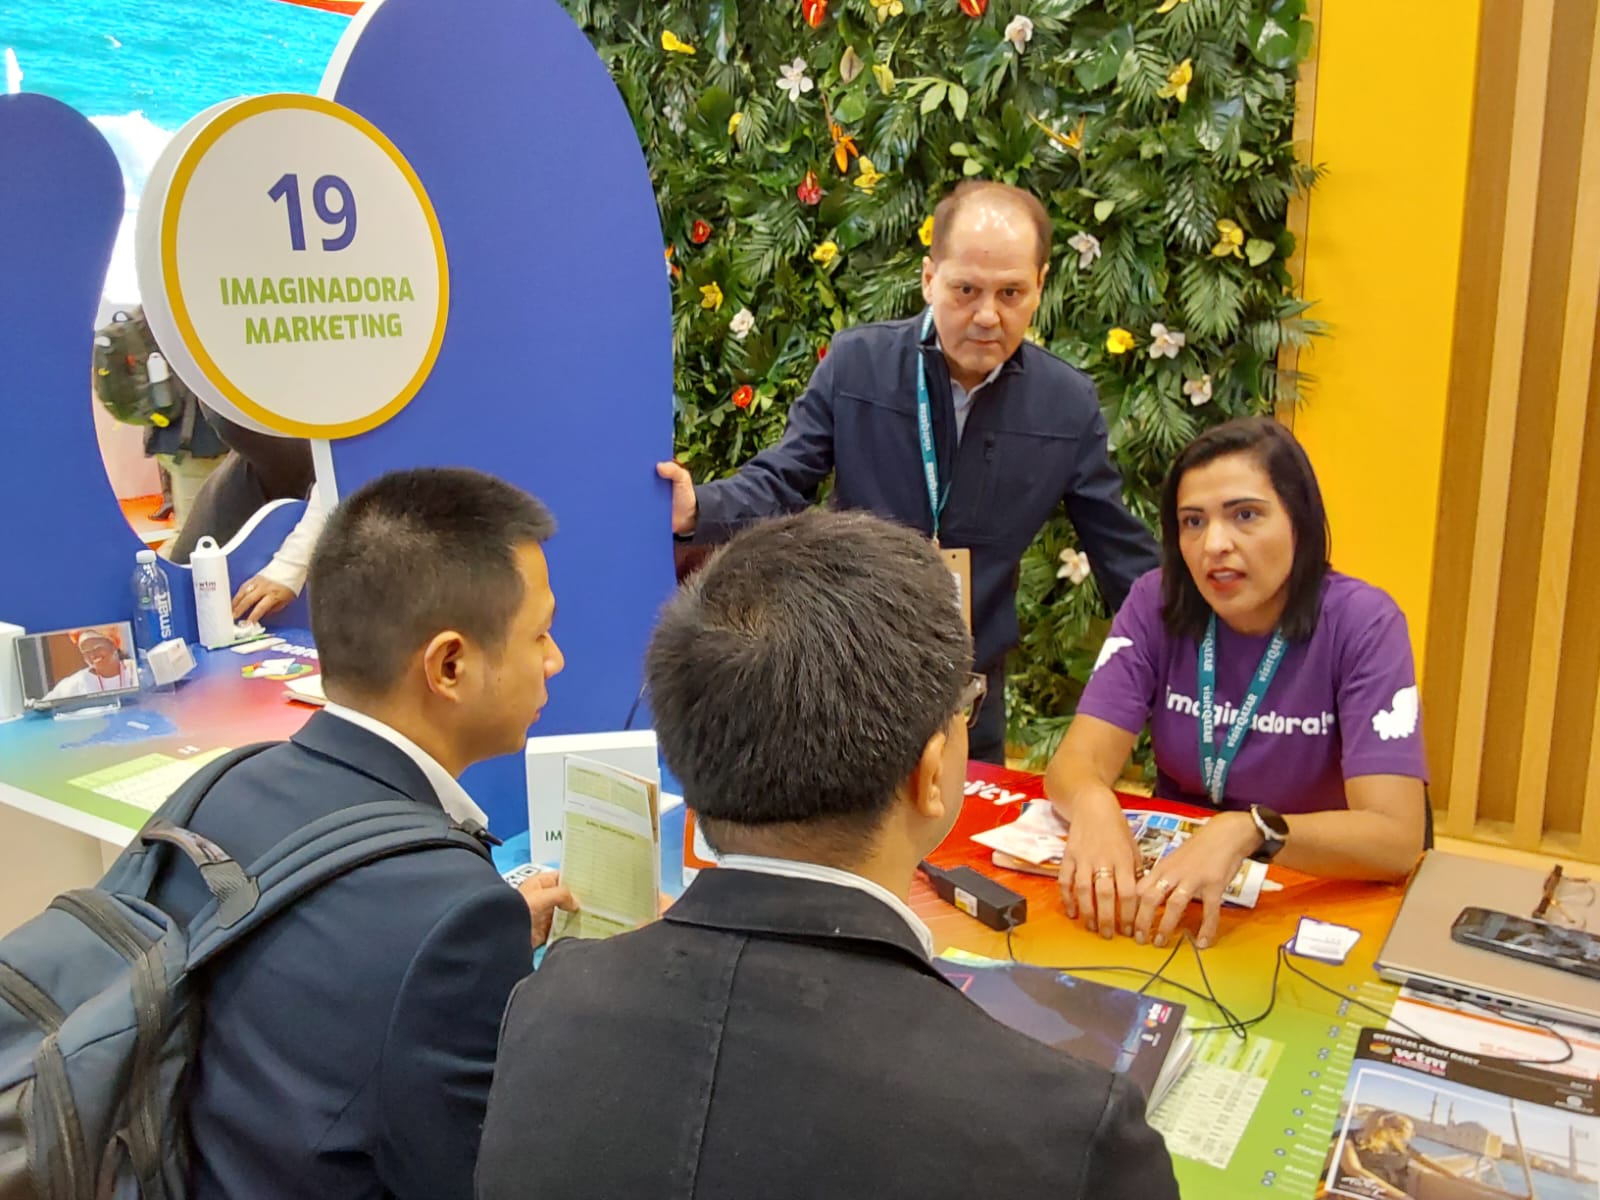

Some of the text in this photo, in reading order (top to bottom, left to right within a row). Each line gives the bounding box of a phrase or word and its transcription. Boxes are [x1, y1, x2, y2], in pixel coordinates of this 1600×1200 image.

[267, 174, 358, 252] 19
[219, 276, 415, 306] IMAGINADORA
[244, 312, 403, 345] MARKETING
[154, 591, 172, 639] smart
